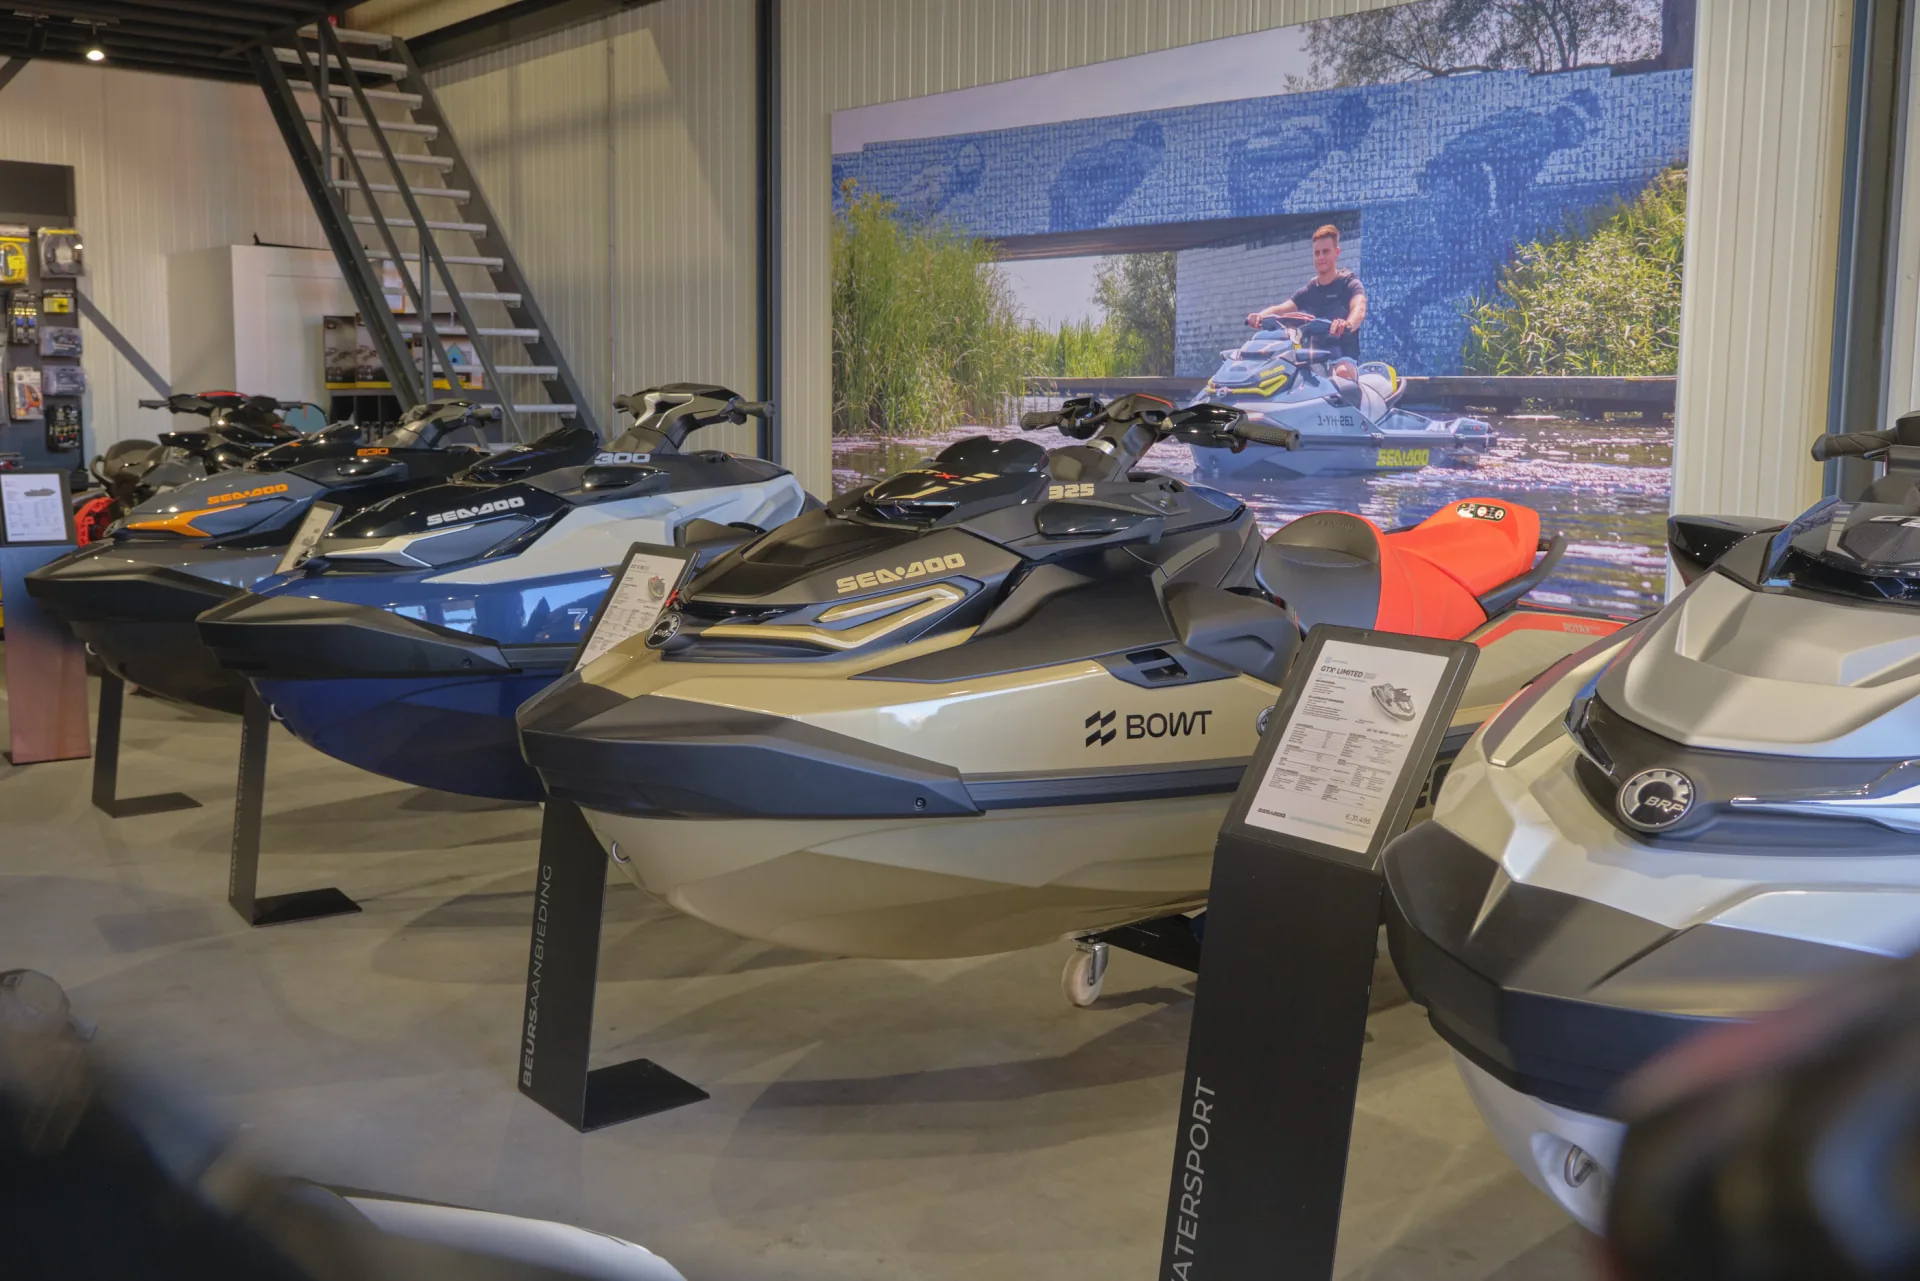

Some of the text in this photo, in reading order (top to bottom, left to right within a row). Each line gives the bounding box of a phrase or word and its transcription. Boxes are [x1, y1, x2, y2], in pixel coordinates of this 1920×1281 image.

[357, 447, 389, 456] 230
[594, 452, 650, 465] 300
[1048, 483, 1094, 499] 325
[1337, 667, 1363, 678] LIMITED
[1126, 710, 1212, 739] BOWT
[1644, 796, 1684, 812] BRP
[522, 865, 553, 1088] BEURSAANBIEDING
[1171, 1077, 1215, 1281] ATERSPORT
